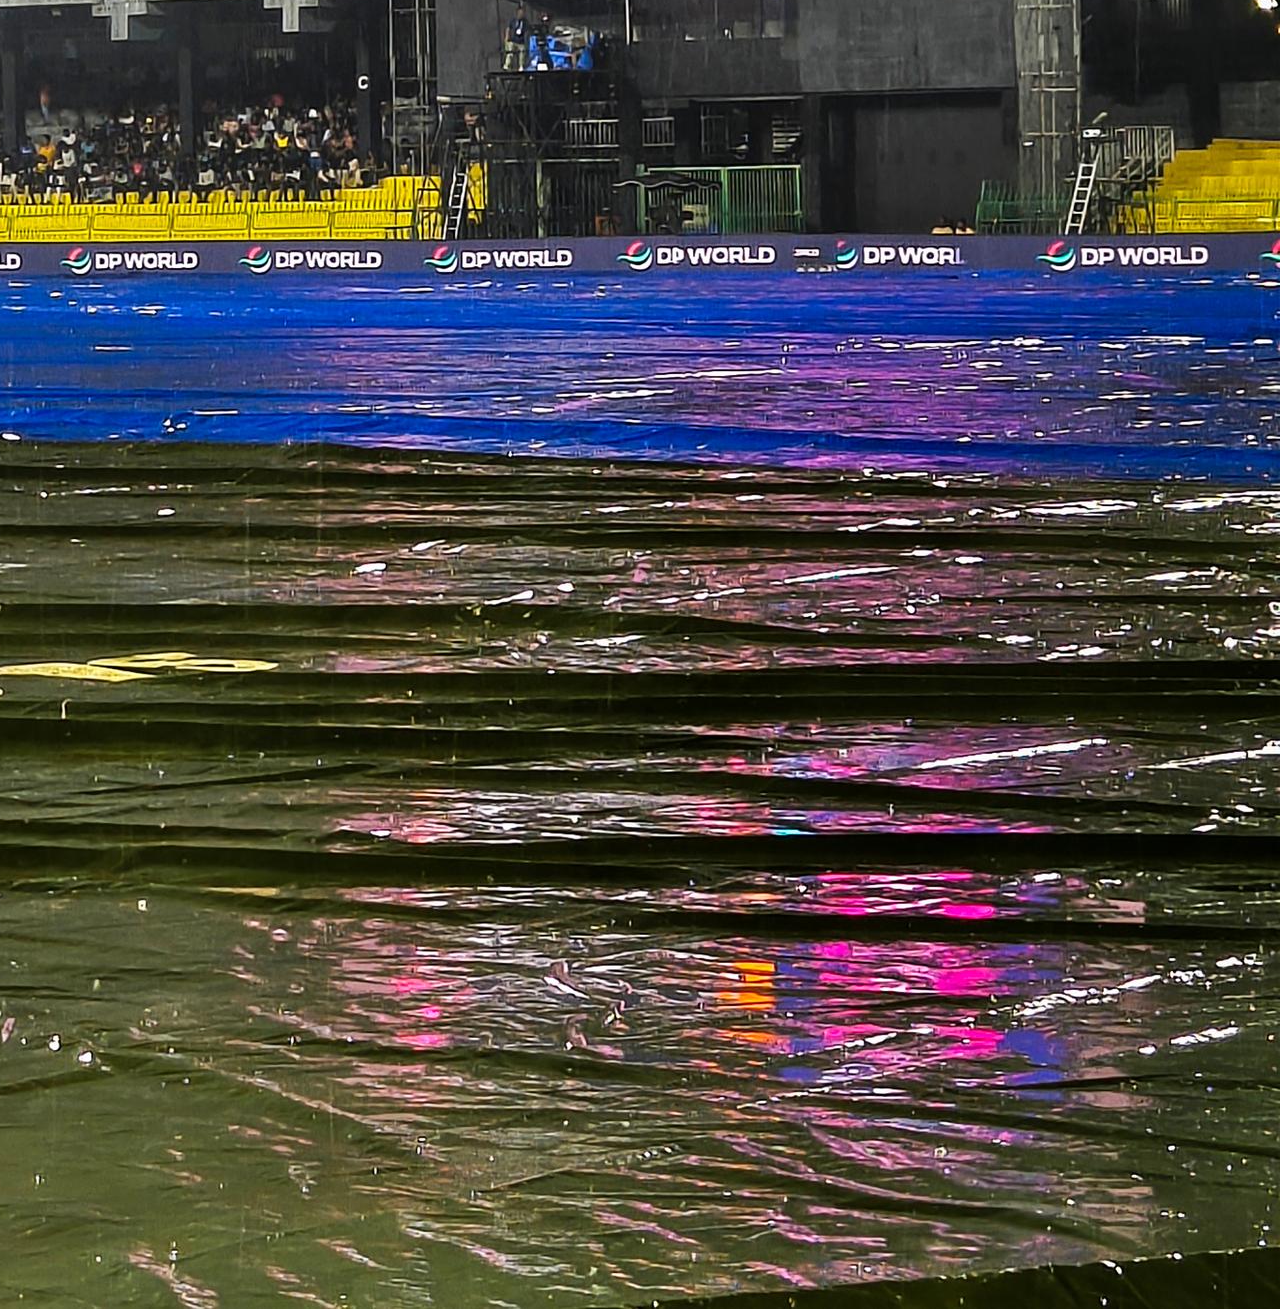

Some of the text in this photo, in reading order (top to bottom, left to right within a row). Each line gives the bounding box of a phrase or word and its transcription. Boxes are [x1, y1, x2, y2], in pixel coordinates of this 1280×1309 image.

[95, 252, 198, 269] DP WORLD
[275, 251, 382, 268] DP WORLD
[462, 249, 573, 268] DP WORLD
[657, 246, 685, 265] DP
[686, 246, 776, 265] WORLD
[863, 246, 964, 265] DP WORL
[1080, 246, 1209, 266] DP WORLD
